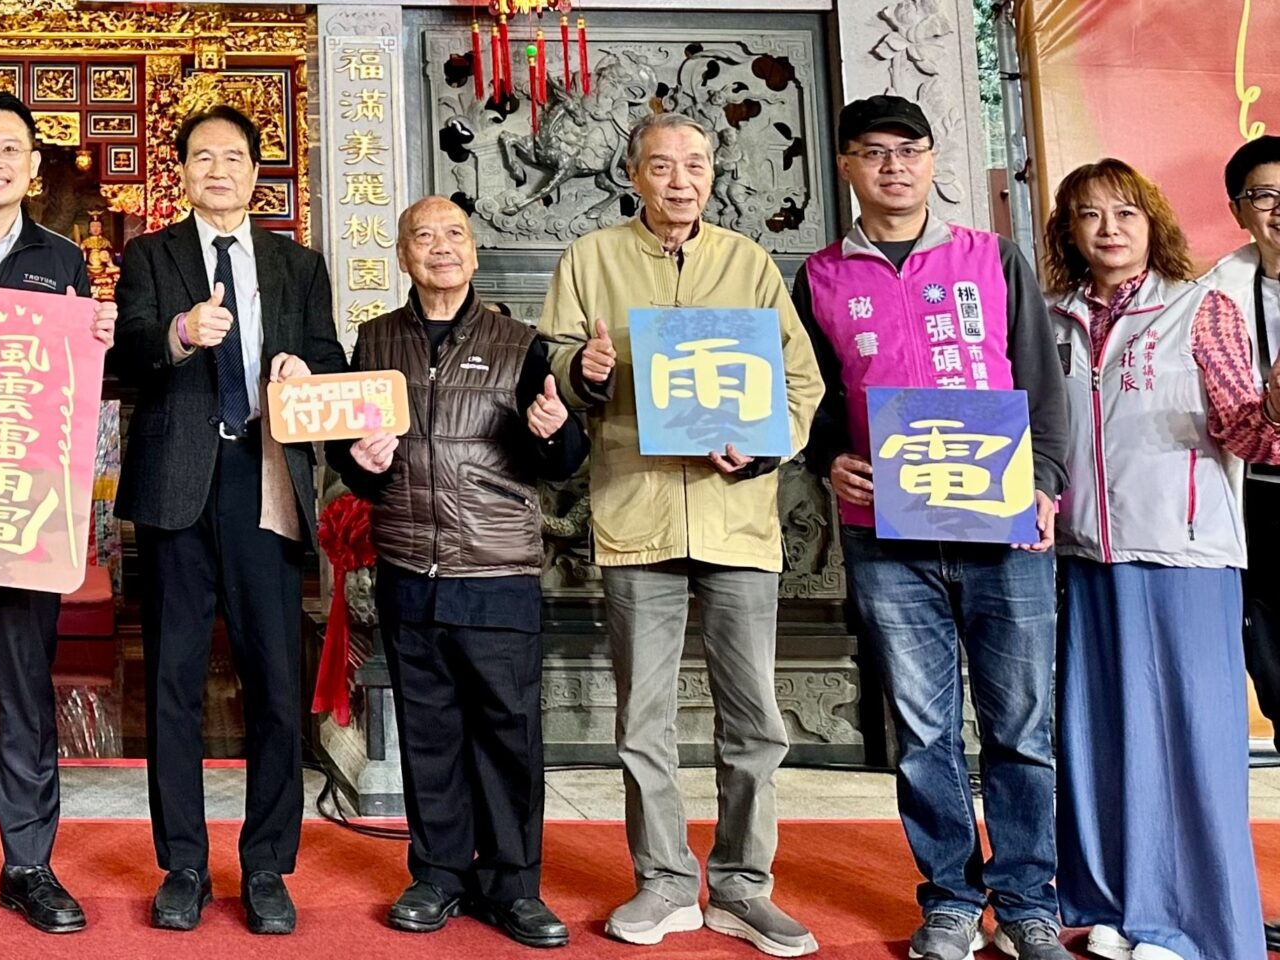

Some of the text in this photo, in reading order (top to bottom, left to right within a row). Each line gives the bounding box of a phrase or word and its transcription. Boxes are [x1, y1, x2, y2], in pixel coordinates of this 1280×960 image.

[24, 273, 57, 287] TAOYUAN
[848, 296, 880, 357] 秘書
[651, 338, 773, 422] 雨
[878, 419, 1034, 519] 電
